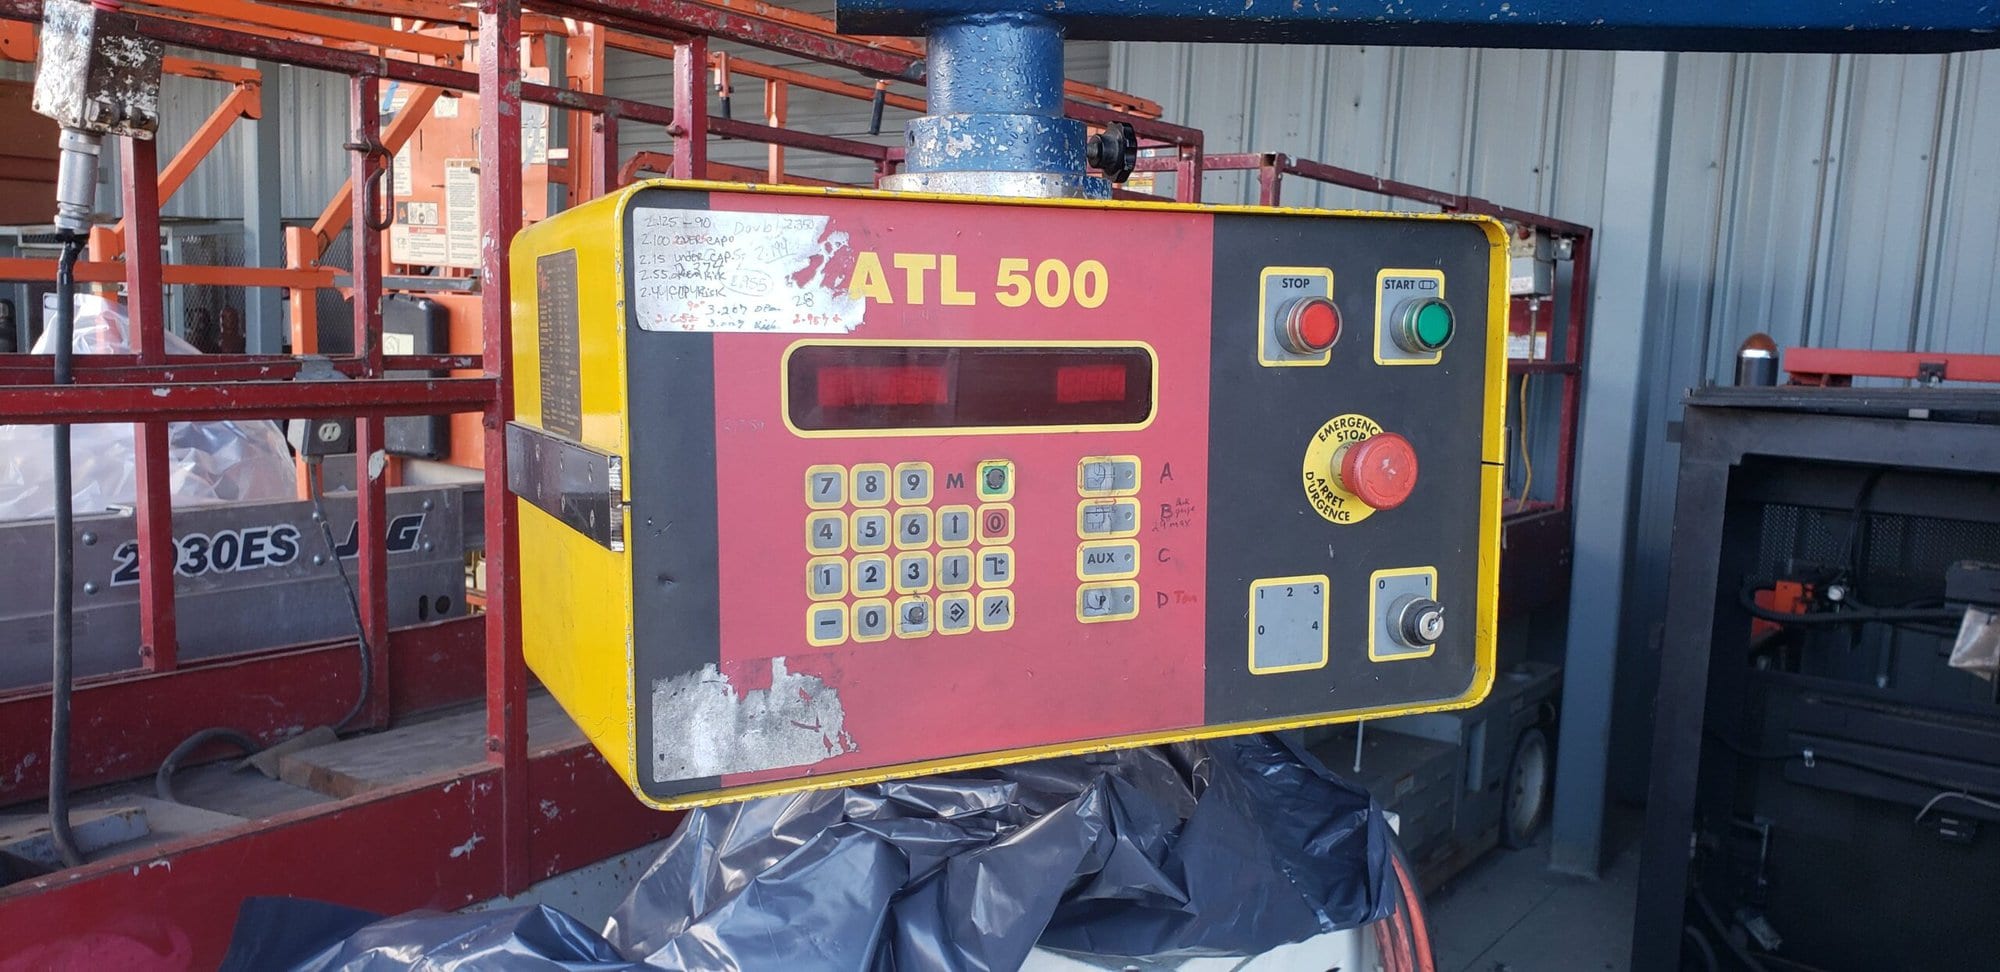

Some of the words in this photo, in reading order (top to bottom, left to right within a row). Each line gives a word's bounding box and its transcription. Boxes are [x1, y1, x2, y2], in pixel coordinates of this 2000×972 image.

[694, 216, 712, 228] 90
[641, 233, 671, 246] 2.100
[638, 254, 666, 265] 2.15
[848, 251, 976, 305] ATL
[995, 258, 1109, 309] 500
[1282, 278, 1310, 289] STOP
[1384, 280, 1415, 290] START
[1318, 417, 1384, 442] EMERGENC
[1336, 430, 1366, 442] STOP
[1159, 462, 1174, 484] A
[820, 477, 834, 494] 7
[865, 475, 878, 493] 8
[907, 474, 920, 491] 9
[946, 473, 964, 489] M
[1305, 471, 1350, 521] D'URGENCE
[1317, 478, 1345, 508] ARRET
[1160, 504, 1173, 519] B
[819, 523, 833, 540] 4
[865, 521, 877, 538] 5
[907, 518, 921, 536] 6
[990, 515, 1001, 531] 0
[111, 523, 300, 587] 230ES
[332, 514, 426, 560] JG
[1158, 548, 1171, 563] C
[1087, 552, 1115, 565] AUX
[824, 569, 831, 585] 1
[865, 566, 877, 583] 2
[907, 563, 920, 580] 3
[1378, 580, 1386, 590] 0
[1424, 576, 1429, 586] 1
[1259, 589, 1264, 599] 1
[1286, 587, 1294, 597] 2
[1312, 585, 1320, 595] 3
[1157, 591, 1169, 609] D
[865, 610, 878, 628] 0
[1257, 625, 1265, 636] 0
[1311, 621, 1319, 631] 4
